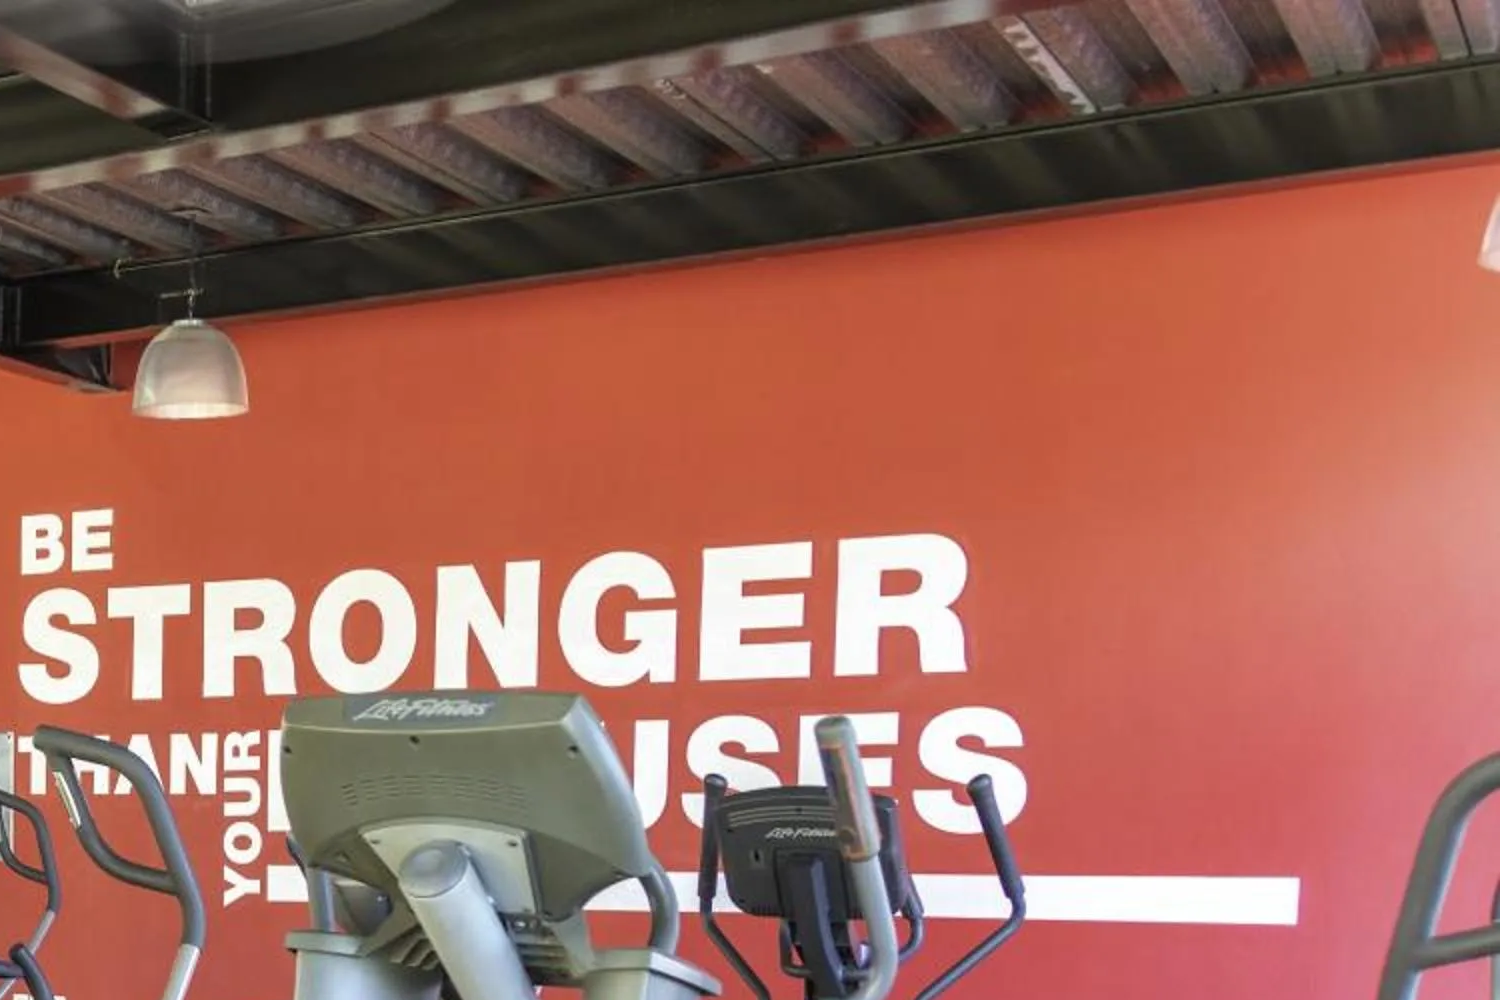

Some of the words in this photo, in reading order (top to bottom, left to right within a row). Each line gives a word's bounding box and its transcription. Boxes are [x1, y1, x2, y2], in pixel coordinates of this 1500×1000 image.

[18, 533, 969, 705] STRONGER
[20, 508, 114, 576] BE
[223, 729, 263, 907] YOUR
